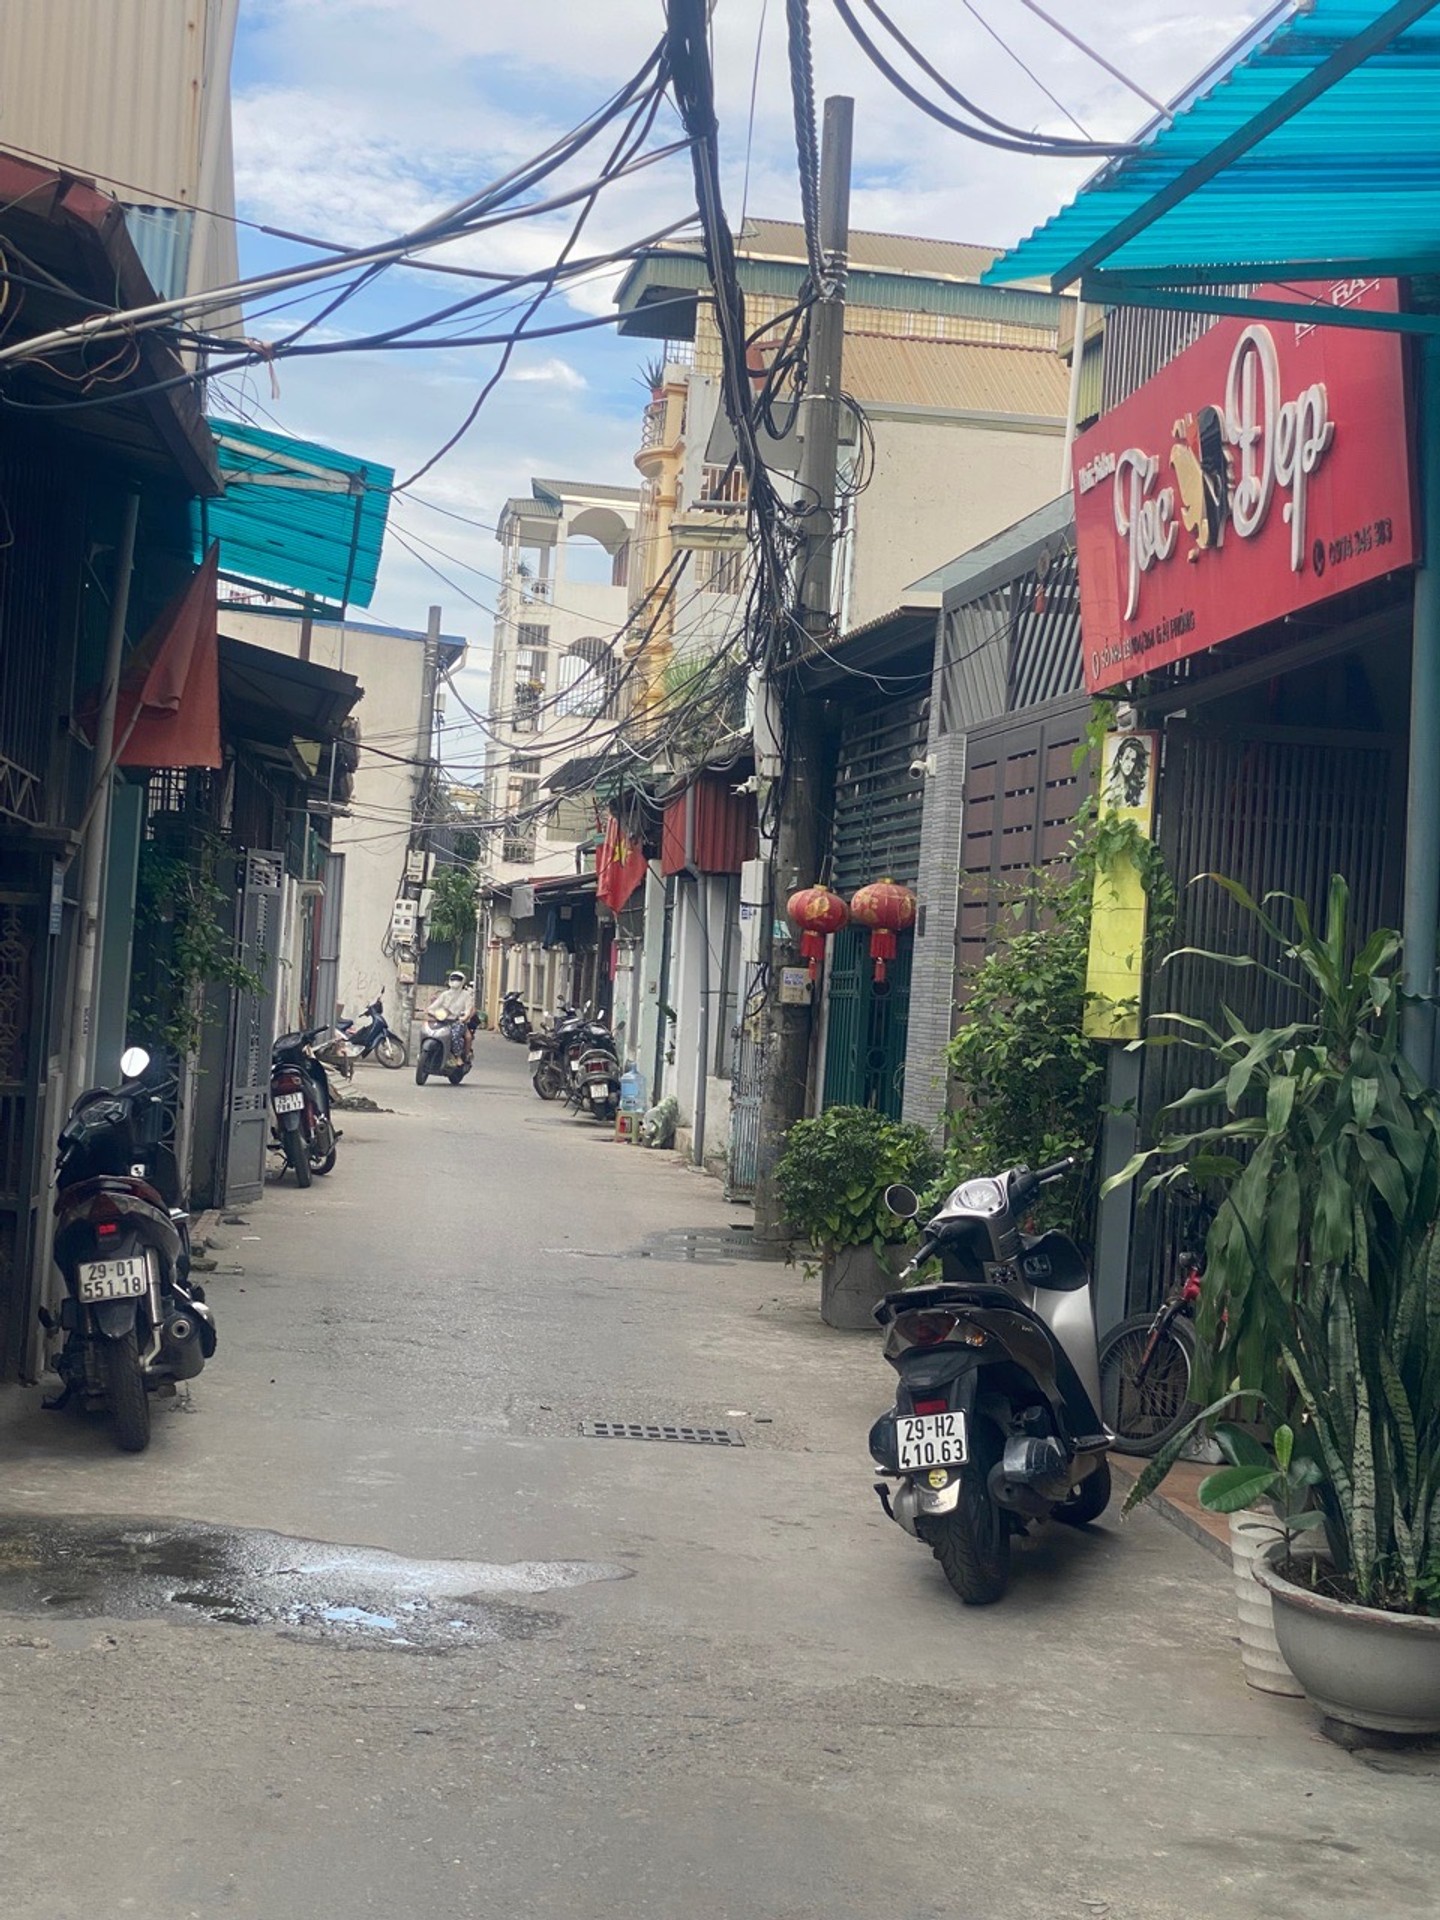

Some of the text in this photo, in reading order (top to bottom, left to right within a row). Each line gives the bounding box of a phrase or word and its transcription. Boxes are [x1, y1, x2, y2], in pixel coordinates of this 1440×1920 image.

[1226, 324, 1335, 573] Đẹp
[87, 1260, 134, 1281] 29-D1
[83, 1276, 141, 1299] 551.18
[904, 1415, 955, 1442] 29-H2
[901, 1439, 963, 1467] 410.63
